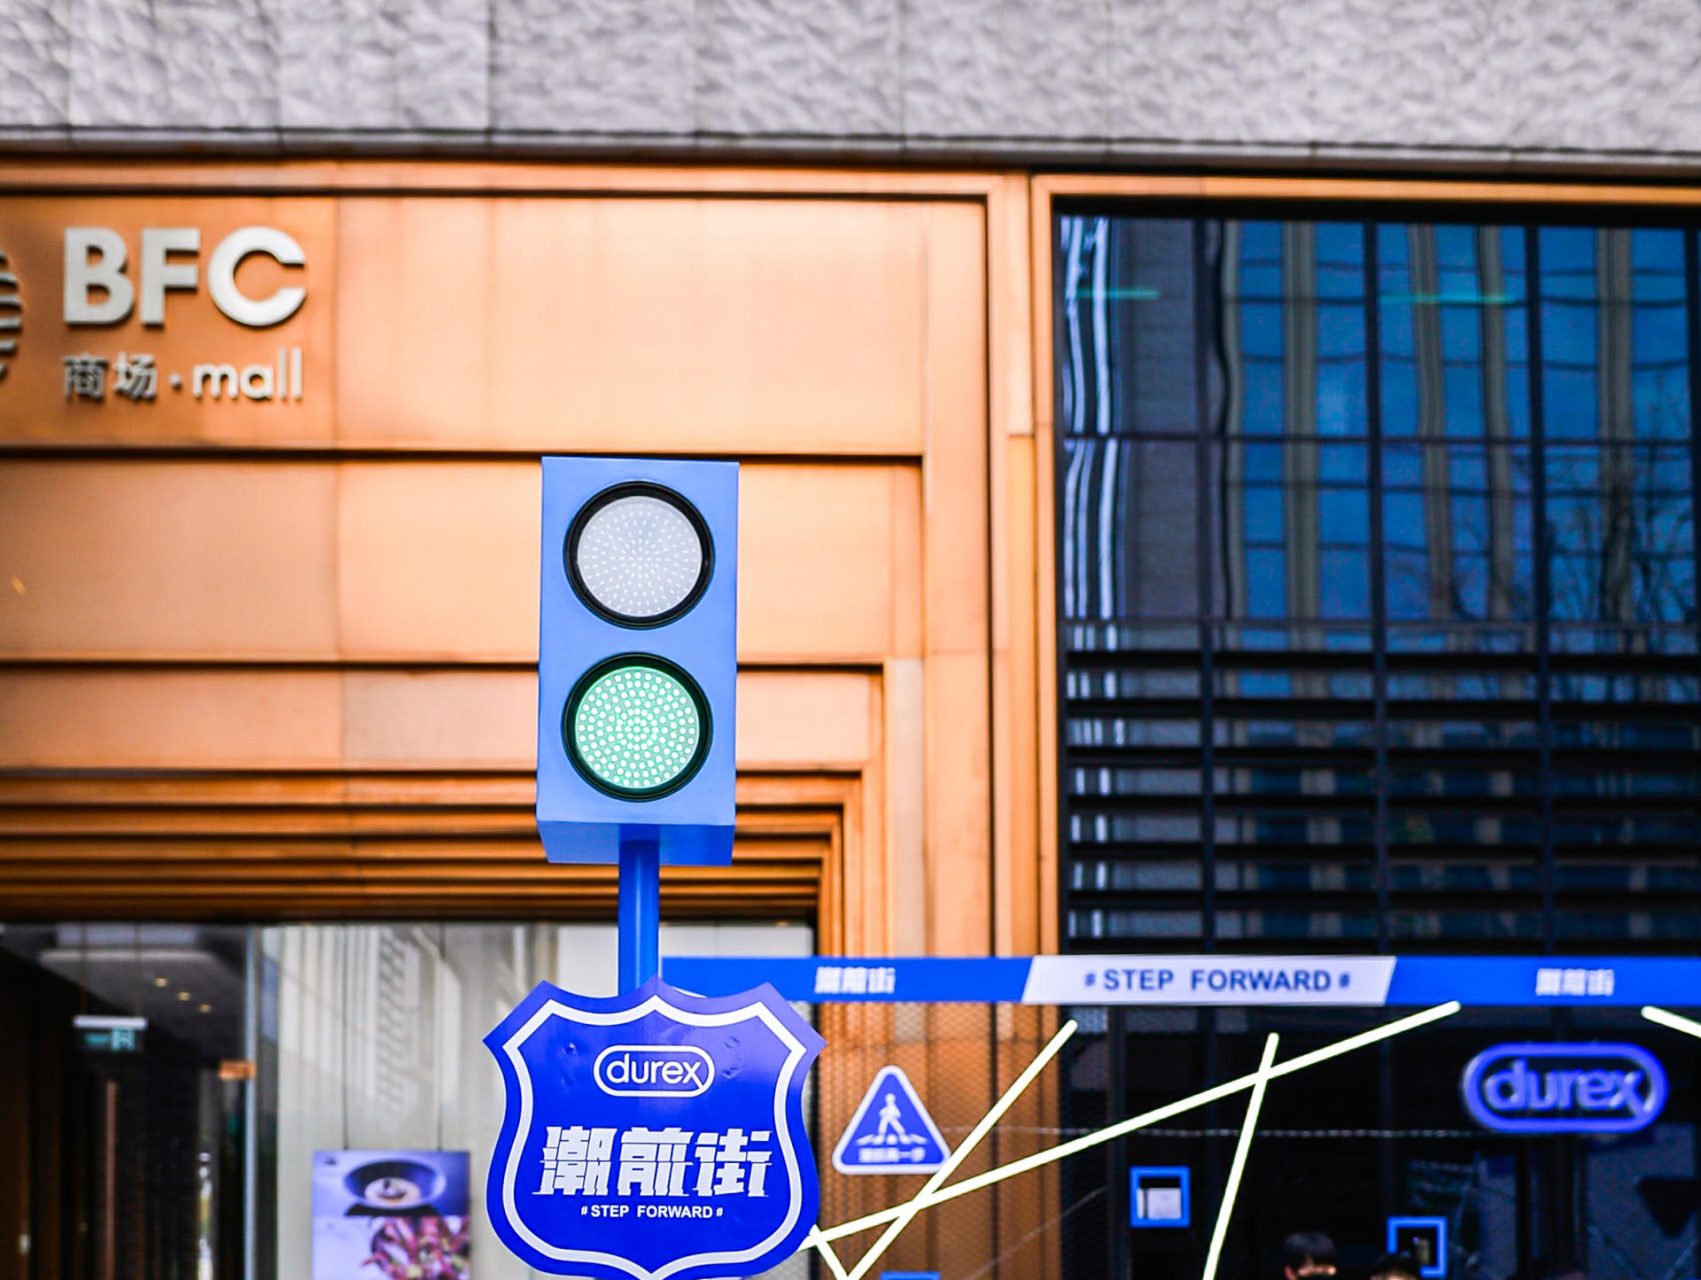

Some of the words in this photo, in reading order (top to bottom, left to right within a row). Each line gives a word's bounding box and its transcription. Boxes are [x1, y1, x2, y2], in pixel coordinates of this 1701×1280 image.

[63, 226, 307, 327] BFC
[606, 1053, 704, 1087] durex
[1483, 1059, 1647, 1115] durex
[532, 1126, 773, 1197] 潮前街
